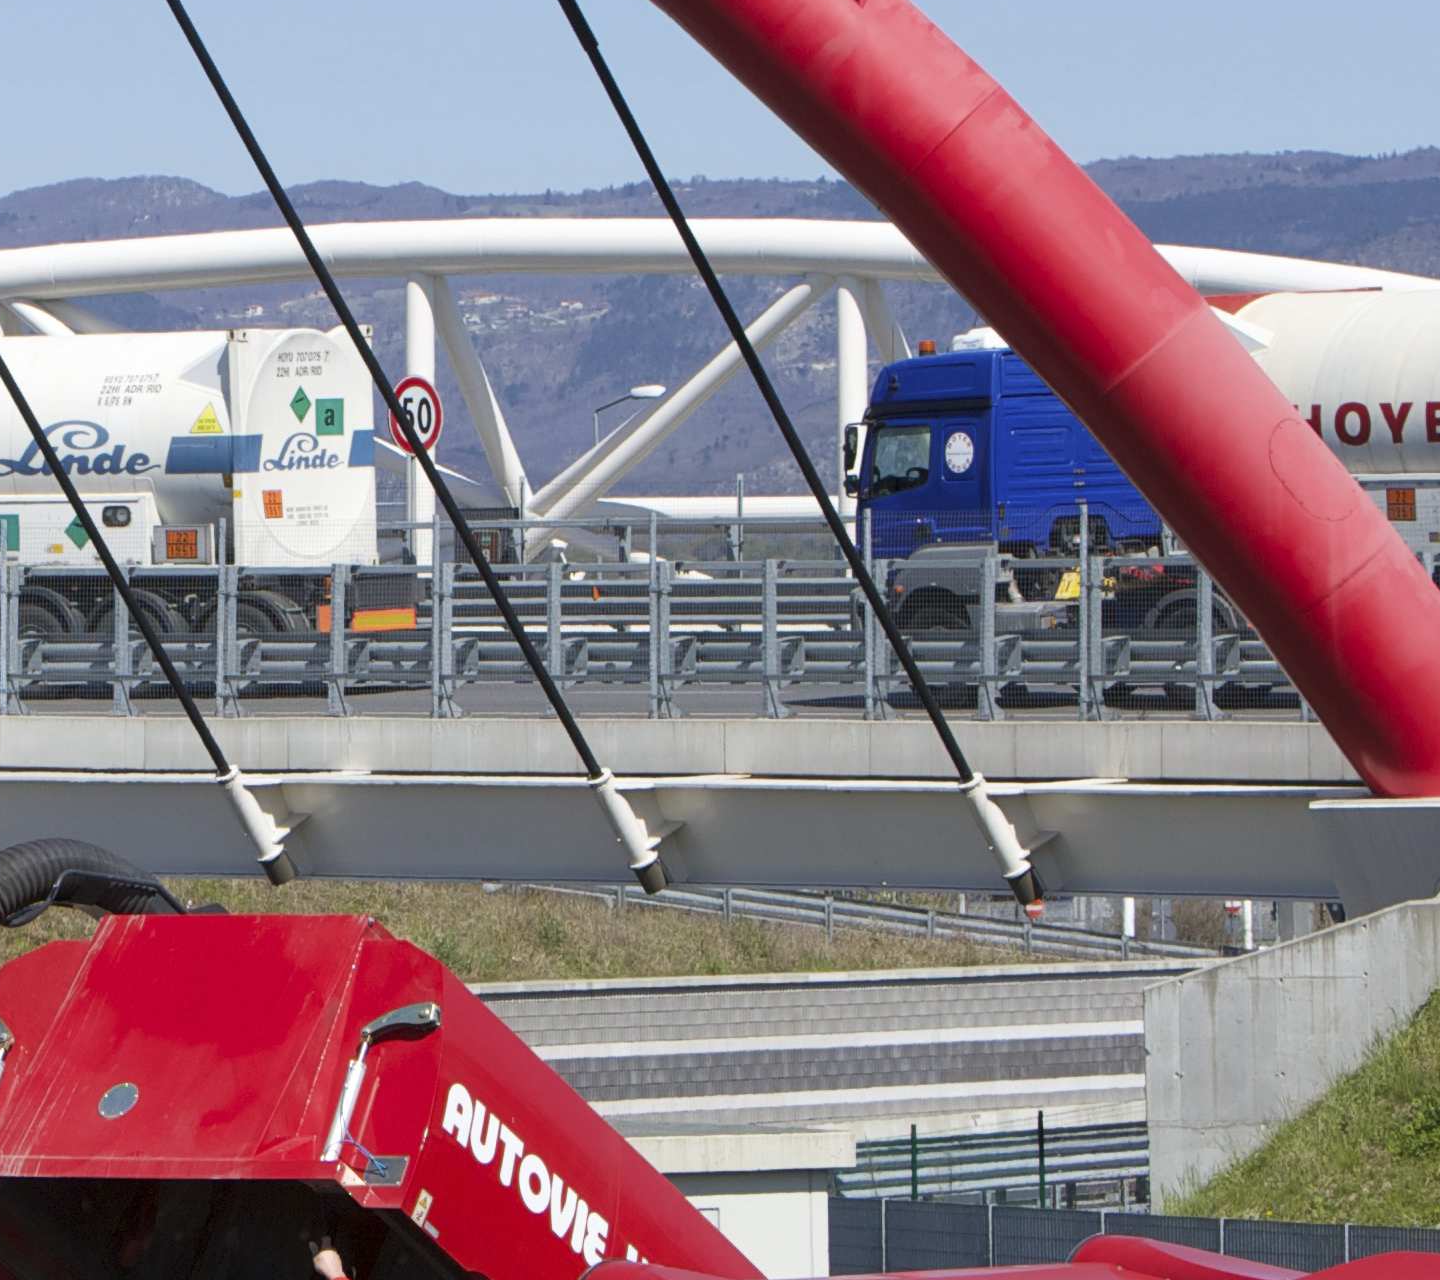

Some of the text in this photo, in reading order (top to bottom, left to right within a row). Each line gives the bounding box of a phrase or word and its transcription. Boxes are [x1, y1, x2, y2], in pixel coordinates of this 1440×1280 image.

[324, 408, 335, 426] a
[403, 397, 432, 434] 50
[263, 432, 344, 471] Linde
[442, 1083, 609, 1267] AUTOVIE
